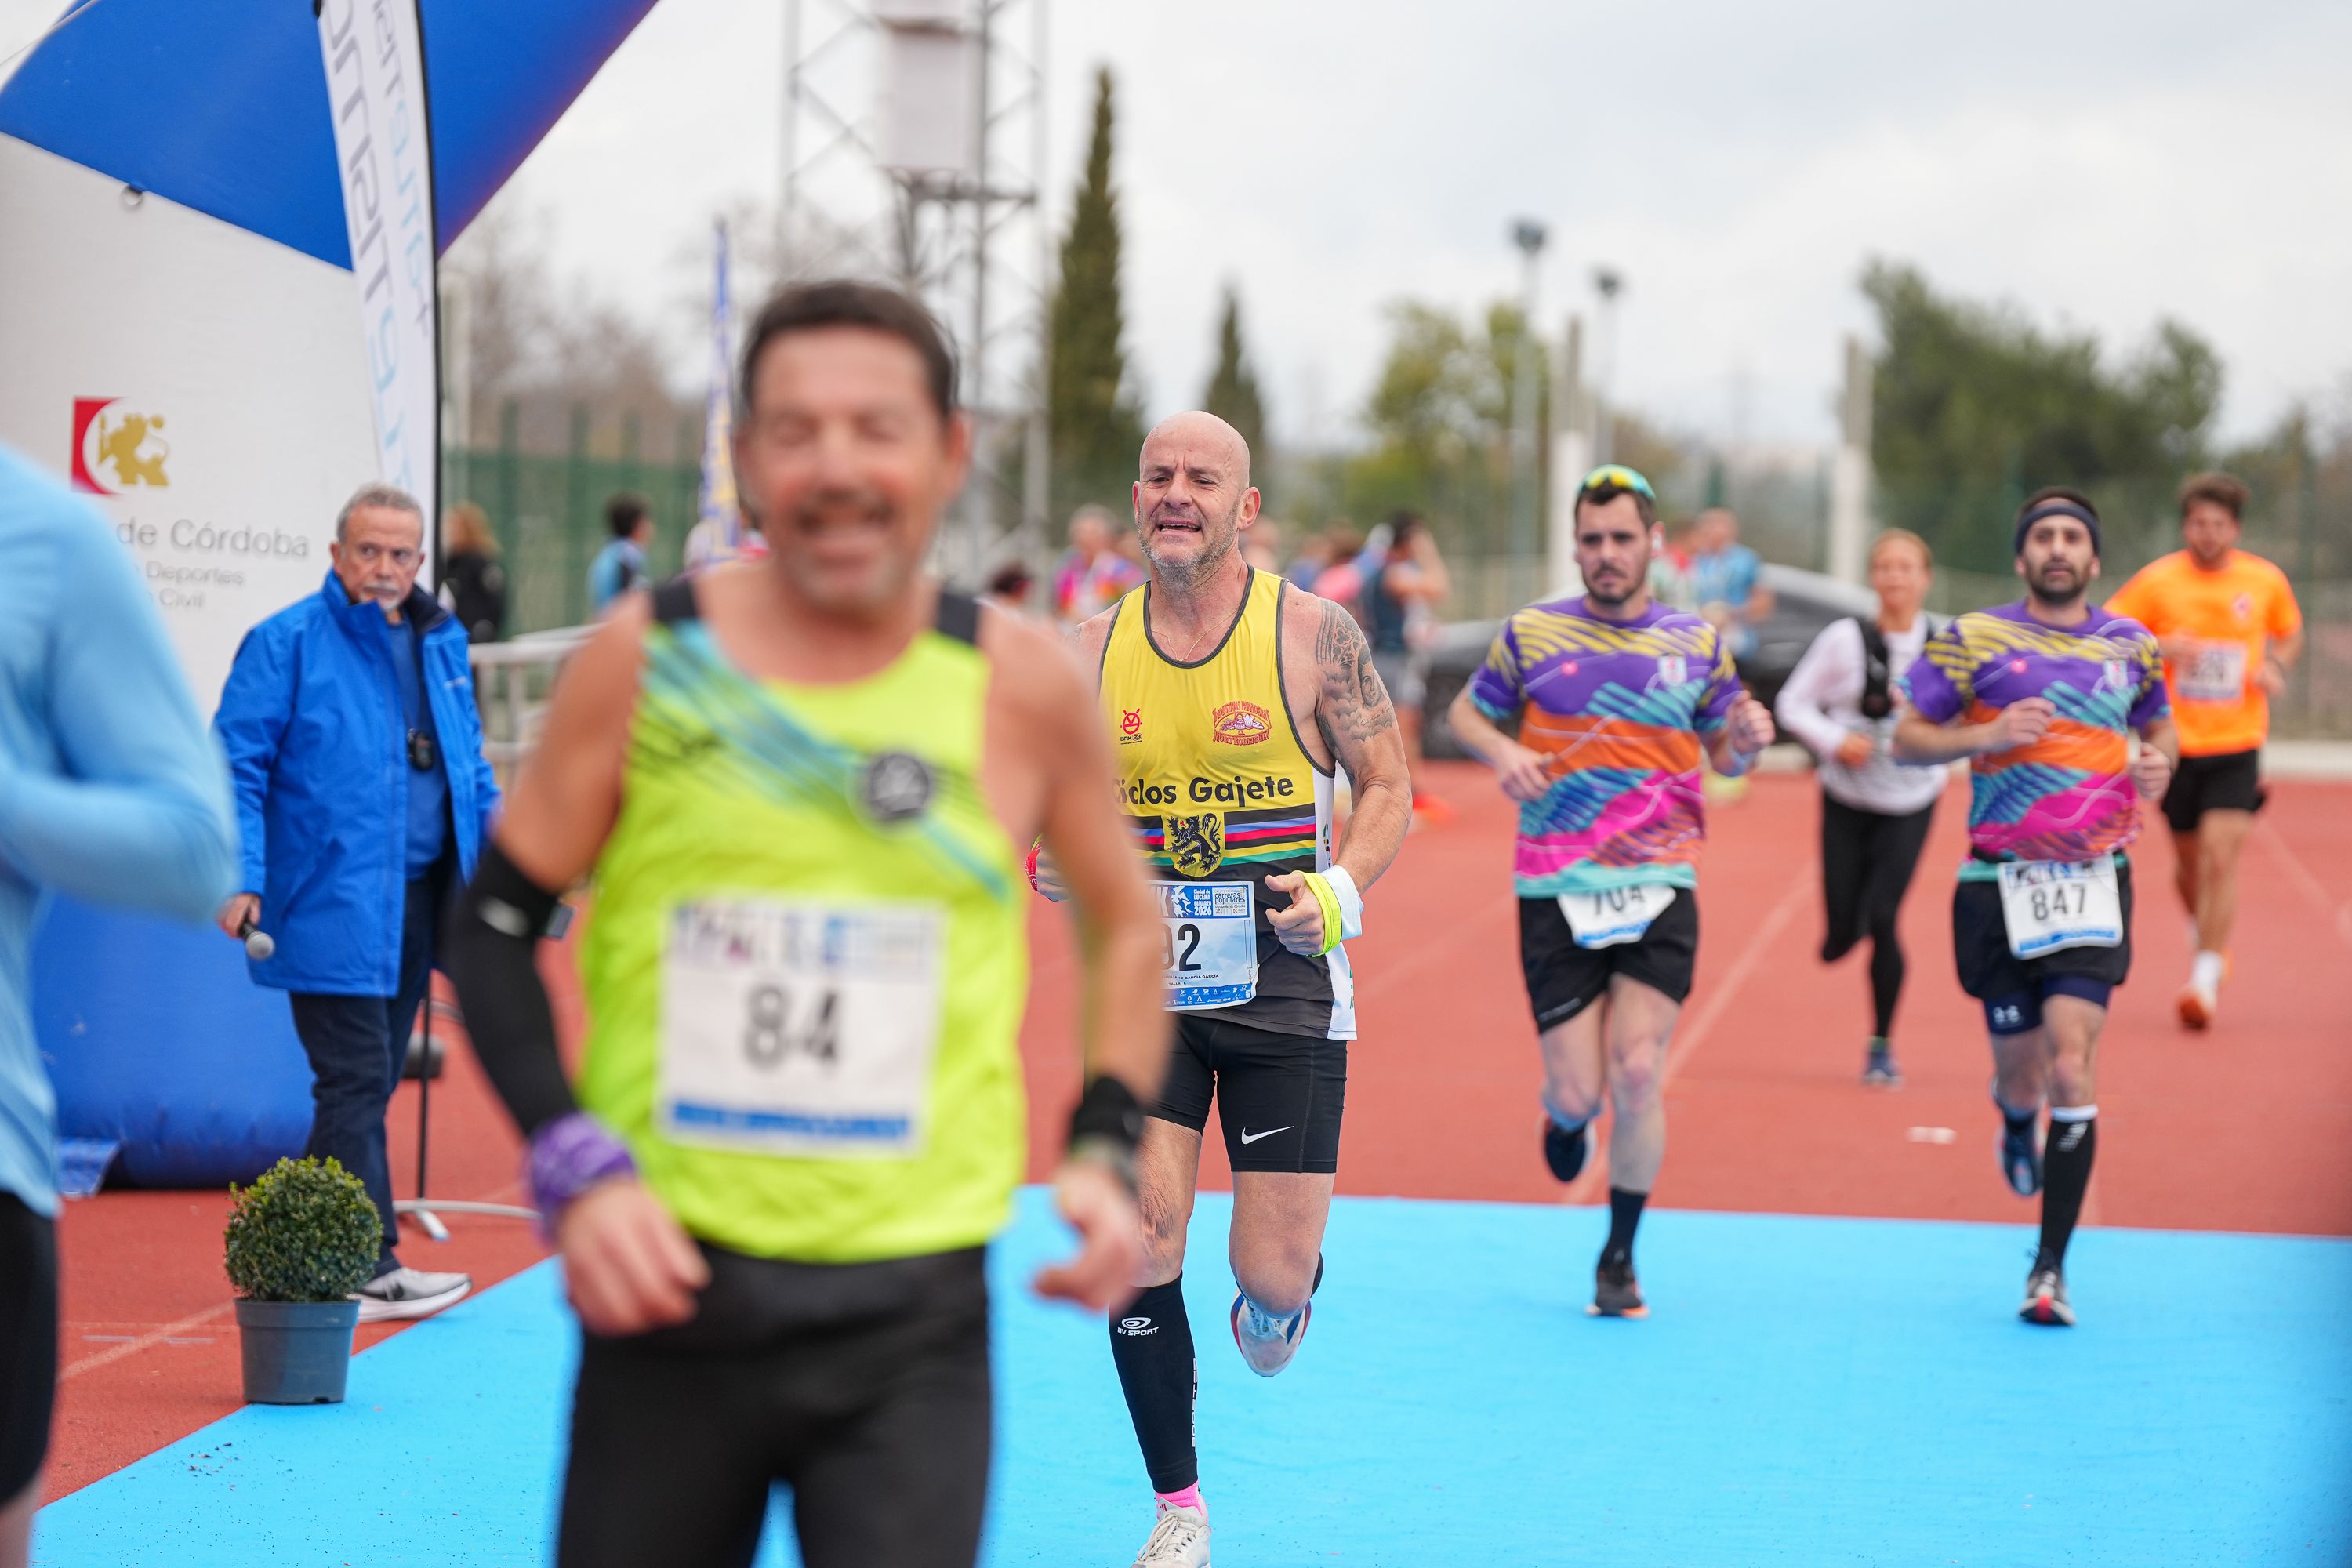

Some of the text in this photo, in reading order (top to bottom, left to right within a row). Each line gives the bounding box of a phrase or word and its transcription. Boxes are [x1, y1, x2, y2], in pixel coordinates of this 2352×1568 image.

[117, 517, 310, 558] de Córdoba
[146, 560, 245, 585] Deportes
[159, 588, 205, 609] Civil
[1189, 776, 1294, 808] Gajete
[1194, 906, 1212, 916] 2026
[2031, 883, 2086, 920] 847
[744, 985, 837, 1073] 84
[1127, 1326, 1160, 1337] SPORT
